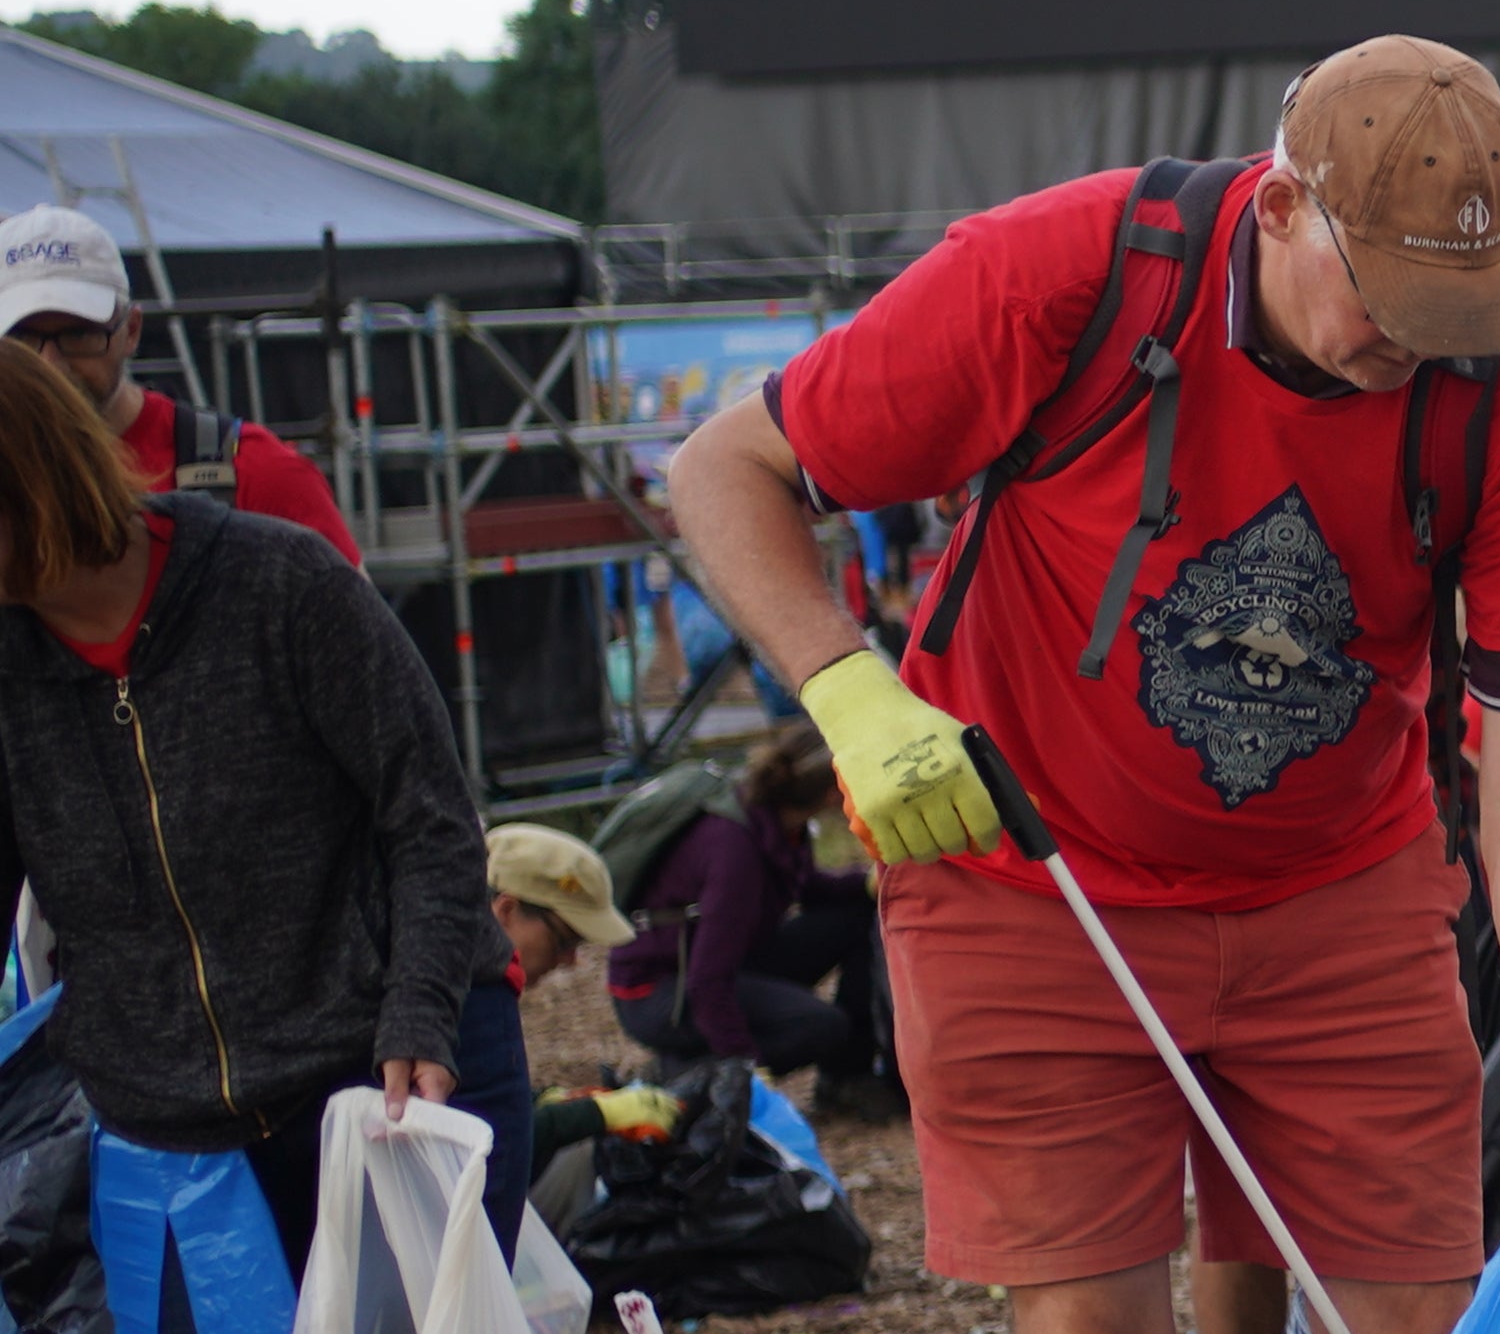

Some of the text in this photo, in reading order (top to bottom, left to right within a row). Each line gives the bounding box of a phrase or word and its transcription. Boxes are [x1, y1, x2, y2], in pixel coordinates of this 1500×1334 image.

[1404, 234, 1470, 251] BURNHAM
[1474, 239, 1482, 250] &
[1239, 565, 1313, 582] GLASTONBURY
[1253, 576, 1298, 590] FESTIVAL
[1195, 691, 1238, 713] LOVE
[1240, 702, 1273, 714] THE
[1275, 704, 1317, 719] FARM
